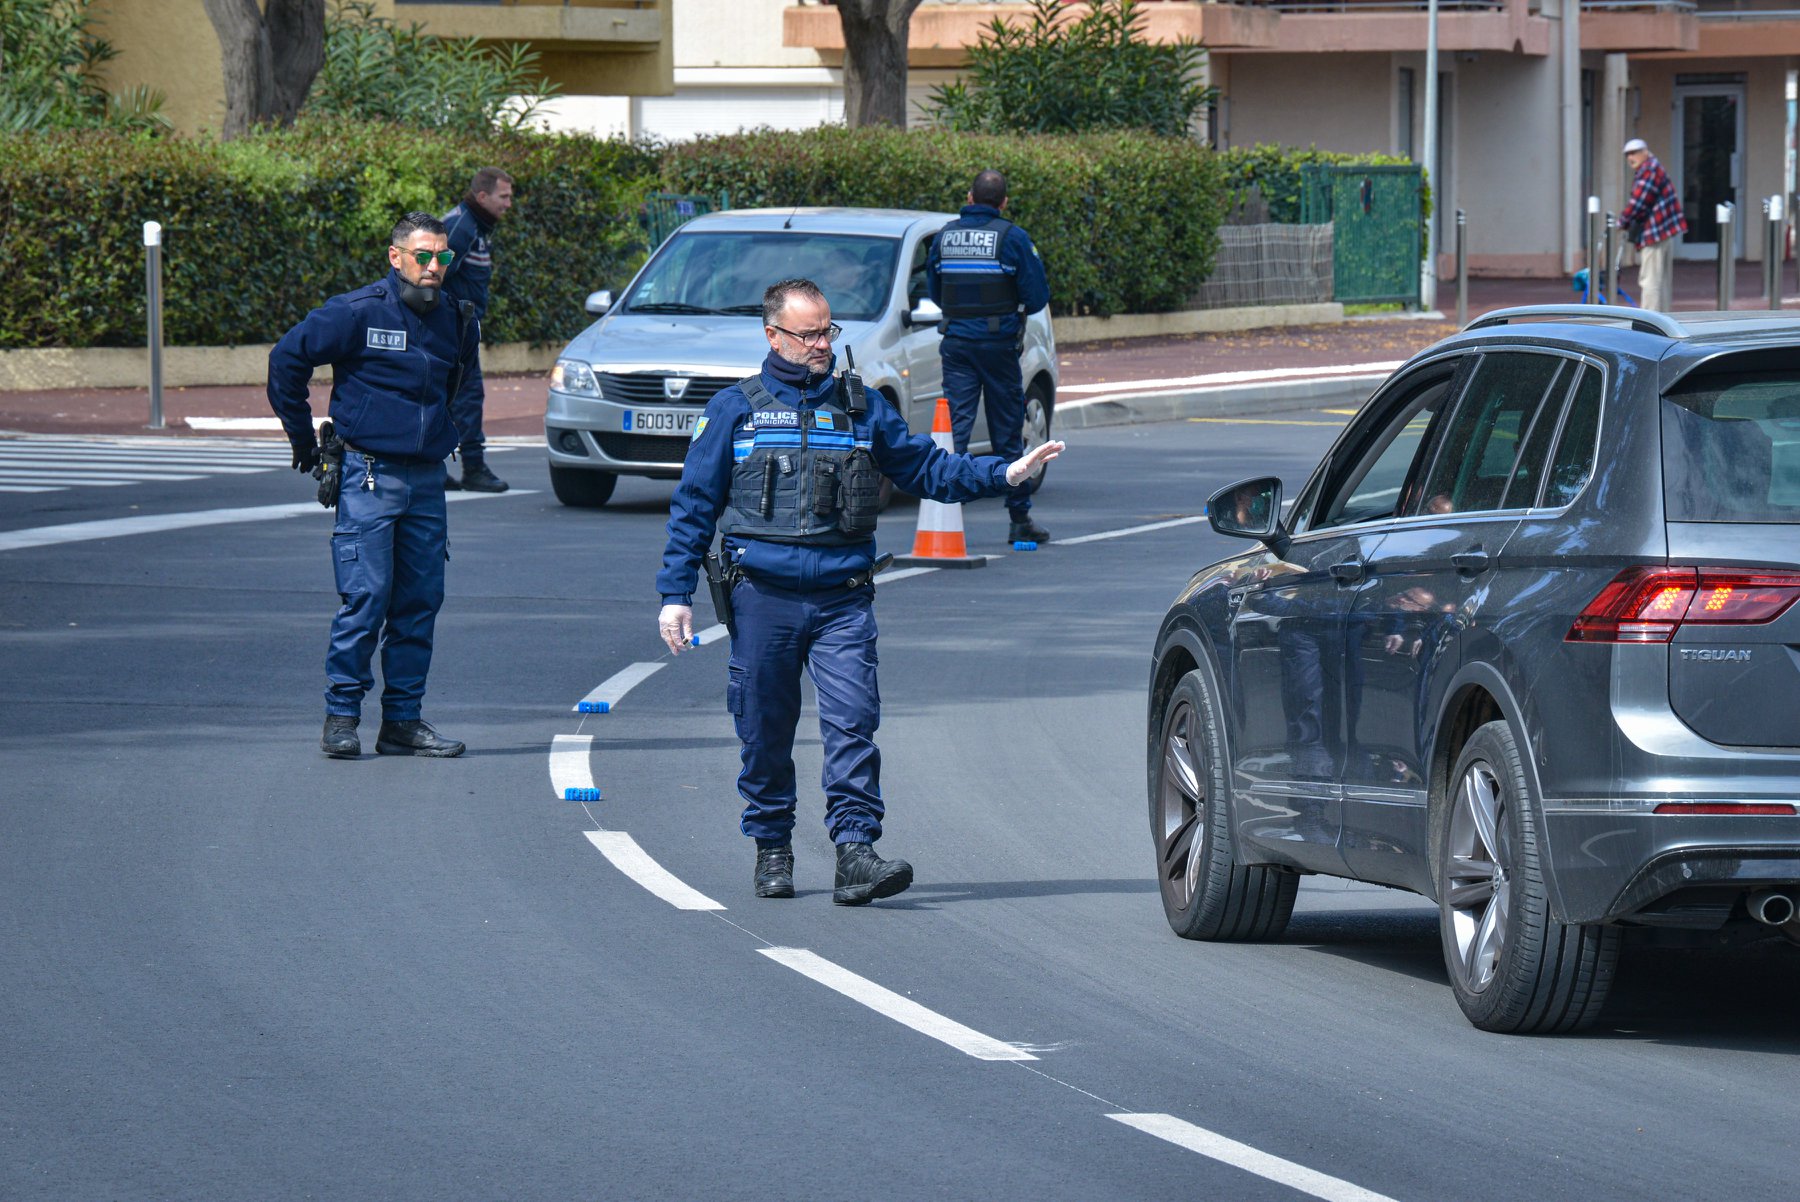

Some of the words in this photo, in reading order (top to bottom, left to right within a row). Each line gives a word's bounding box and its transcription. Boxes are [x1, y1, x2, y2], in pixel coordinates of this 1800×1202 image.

[943, 231, 994, 246] POLICE
[943, 246, 993, 257] MUNICIPALE
[636, 413, 673, 430] 6003
[677, 414, 694, 430] VF
[753, 411, 798, 420] POLICE
[1680, 649, 1752, 661] TIGUAN
